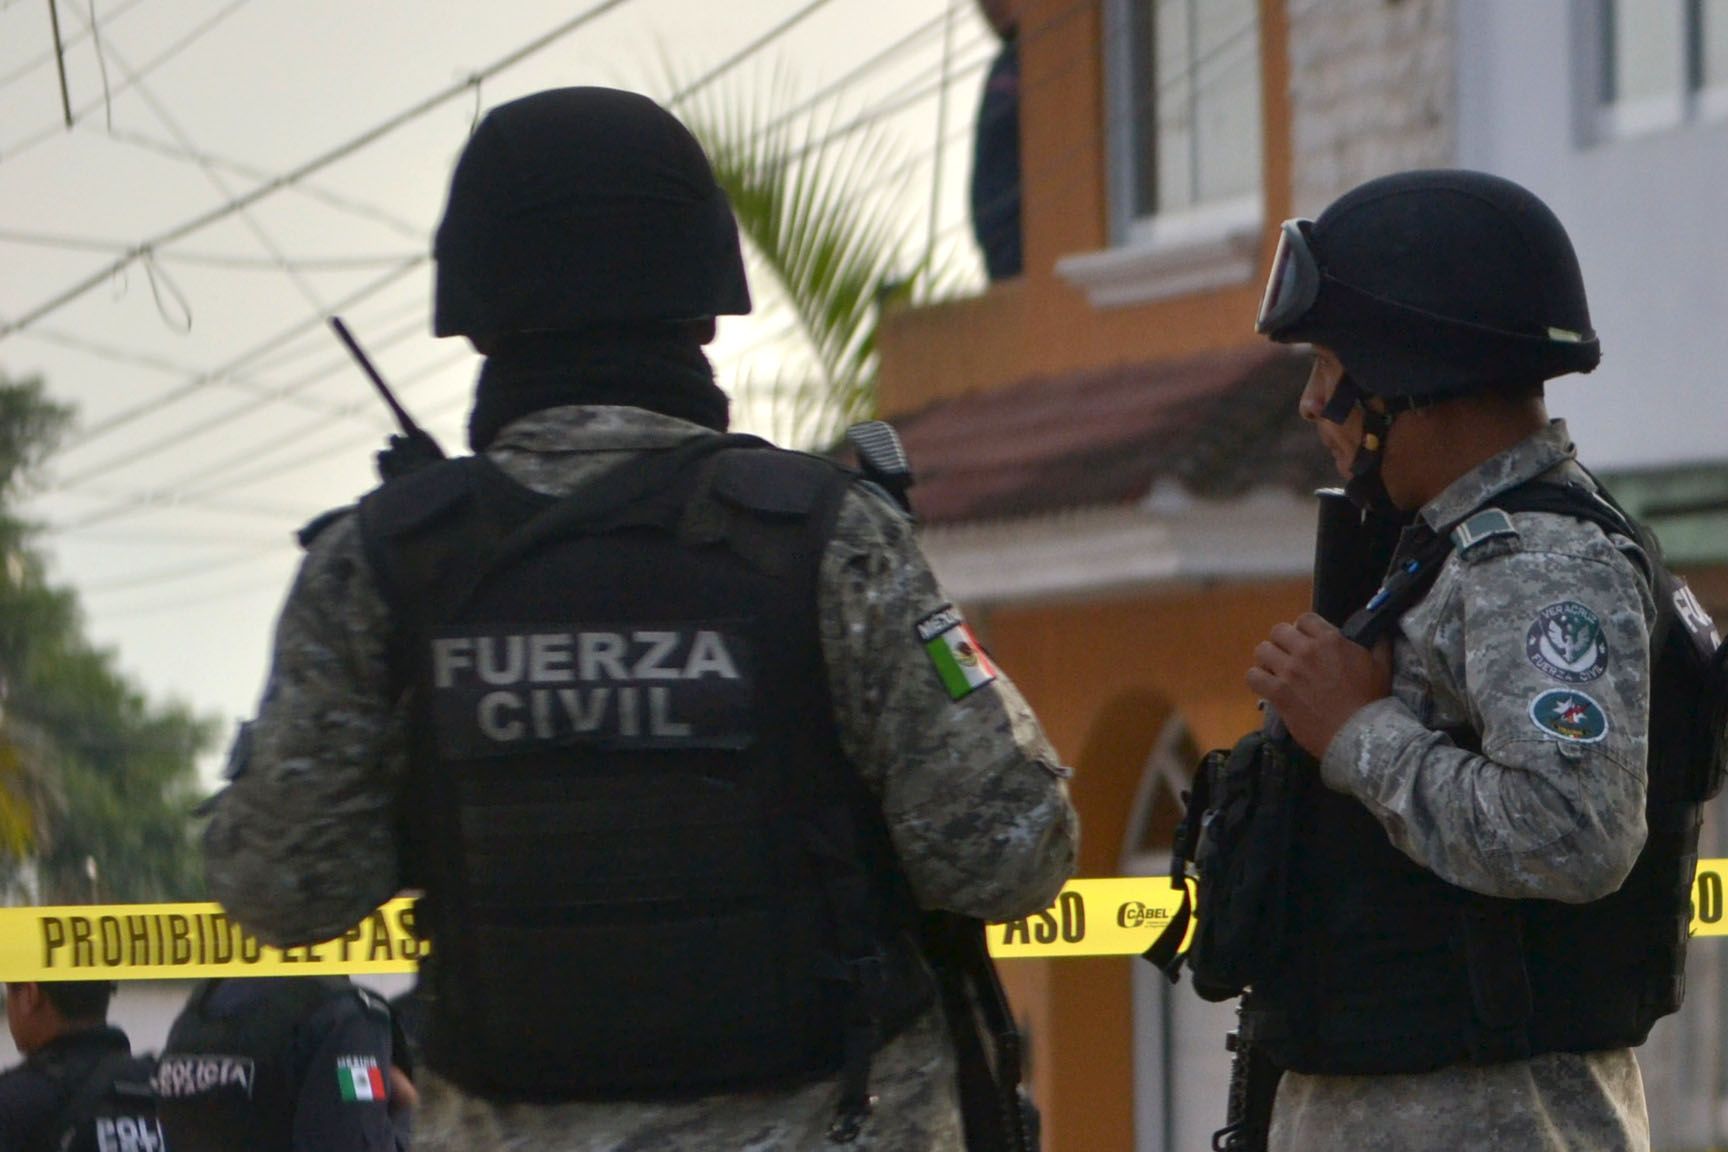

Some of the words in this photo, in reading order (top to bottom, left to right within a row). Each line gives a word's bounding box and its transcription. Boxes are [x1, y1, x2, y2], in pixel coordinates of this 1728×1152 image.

[1541, 603, 1599, 625] VERACRUZ
[433, 630, 741, 688] FUERZA
[1531, 653, 1573, 681] FUERZA
[1580, 664, 1603, 681] CIVIL
[478, 687, 693, 742] CIVIL
